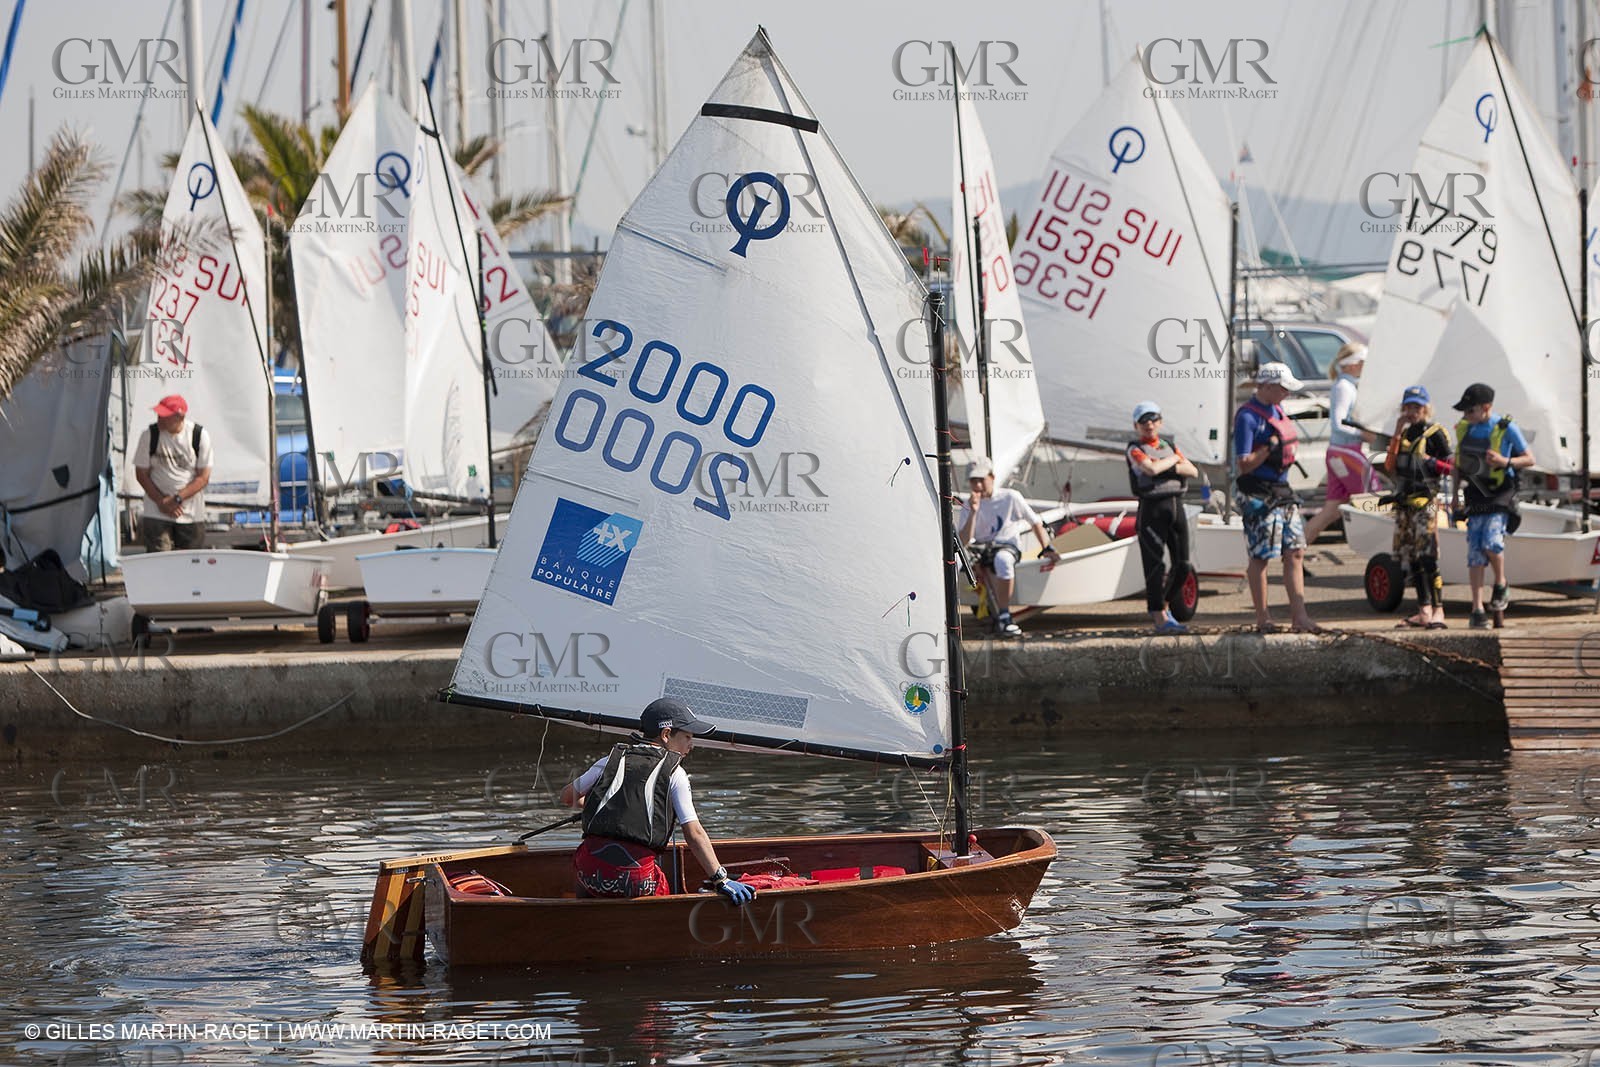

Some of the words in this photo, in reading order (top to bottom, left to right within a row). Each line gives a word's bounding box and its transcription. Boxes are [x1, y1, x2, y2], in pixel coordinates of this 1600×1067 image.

[1025, 209, 1120, 279] 1536
[1117, 209, 1182, 267] SUI
[1407, 198, 1498, 264] 1779
[577, 320, 776, 447] 2000
[537, 568, 612, 600] POPULAIRE
[540, 556, 615, 589] BANQUE
